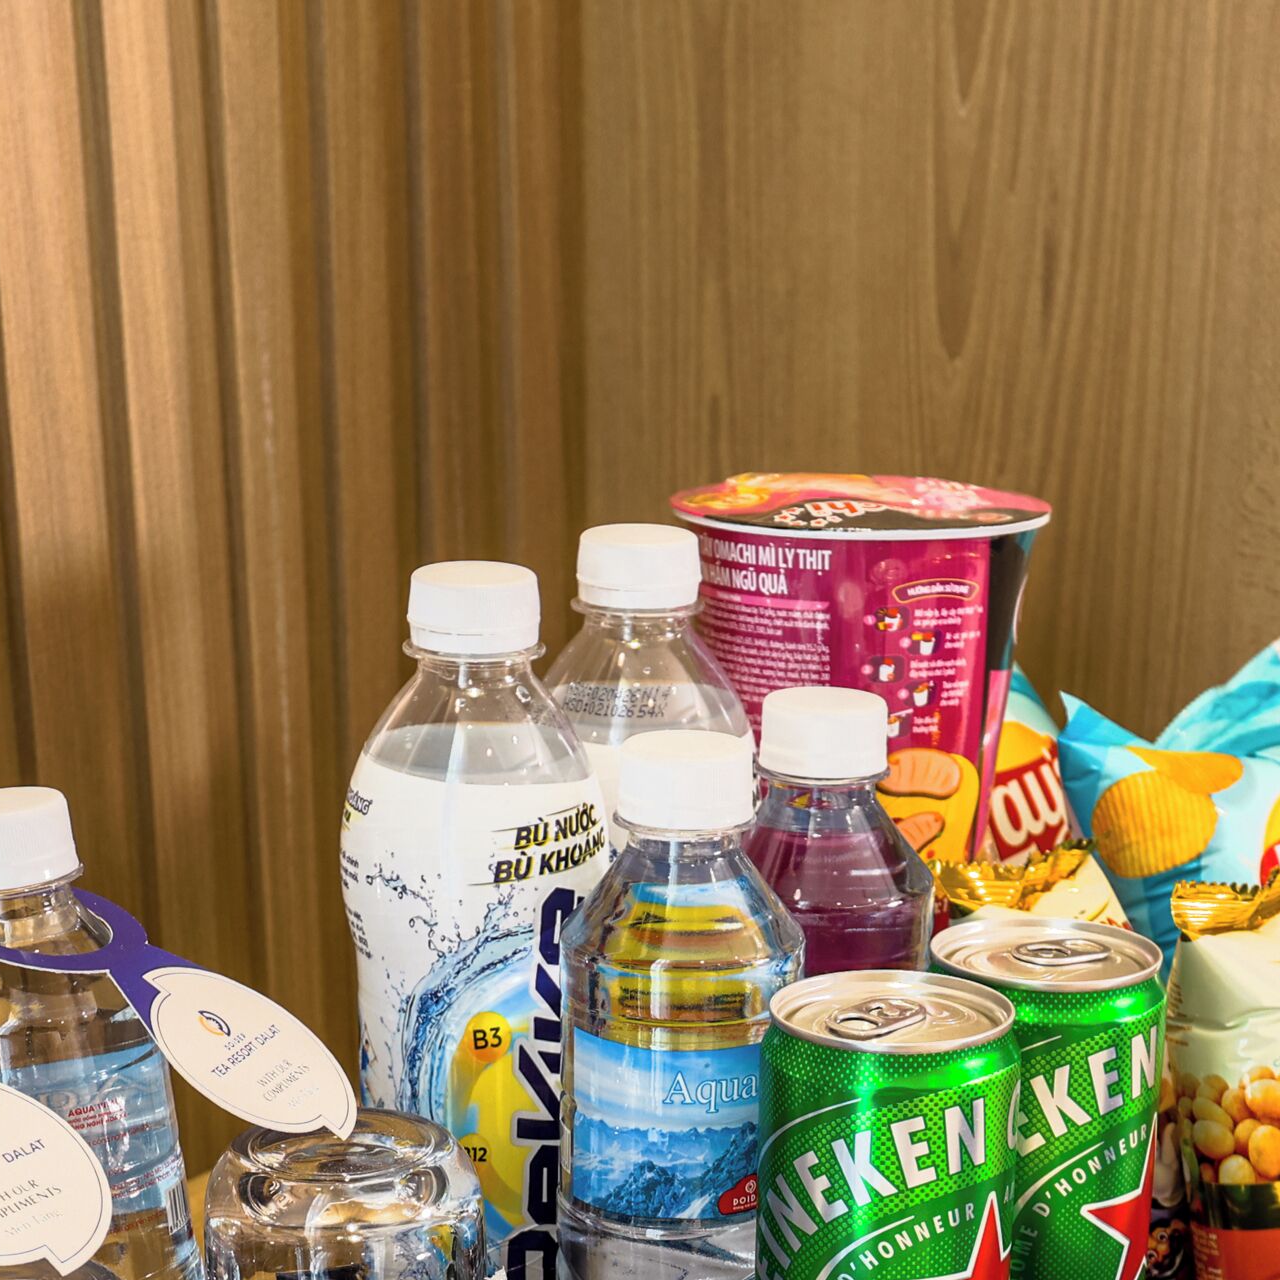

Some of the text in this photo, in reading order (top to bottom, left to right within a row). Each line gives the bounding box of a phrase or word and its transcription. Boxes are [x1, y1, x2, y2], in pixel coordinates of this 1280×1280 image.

[797, 548, 833, 576] THỊT
[758, 568, 788, 596] QUẢ
[514, 801, 597, 850] BÙ NƯỚC
[493, 851, 534, 883] BÙ
[472, 1026, 503, 1051] B3
[210, 1062, 231, 1079] TEA
[662, 1070, 759, 1114] Aqua
[1, 1138, 46, 1164] DALAT
[1031, 1123, 1149, 1219] D'HONNEUR
